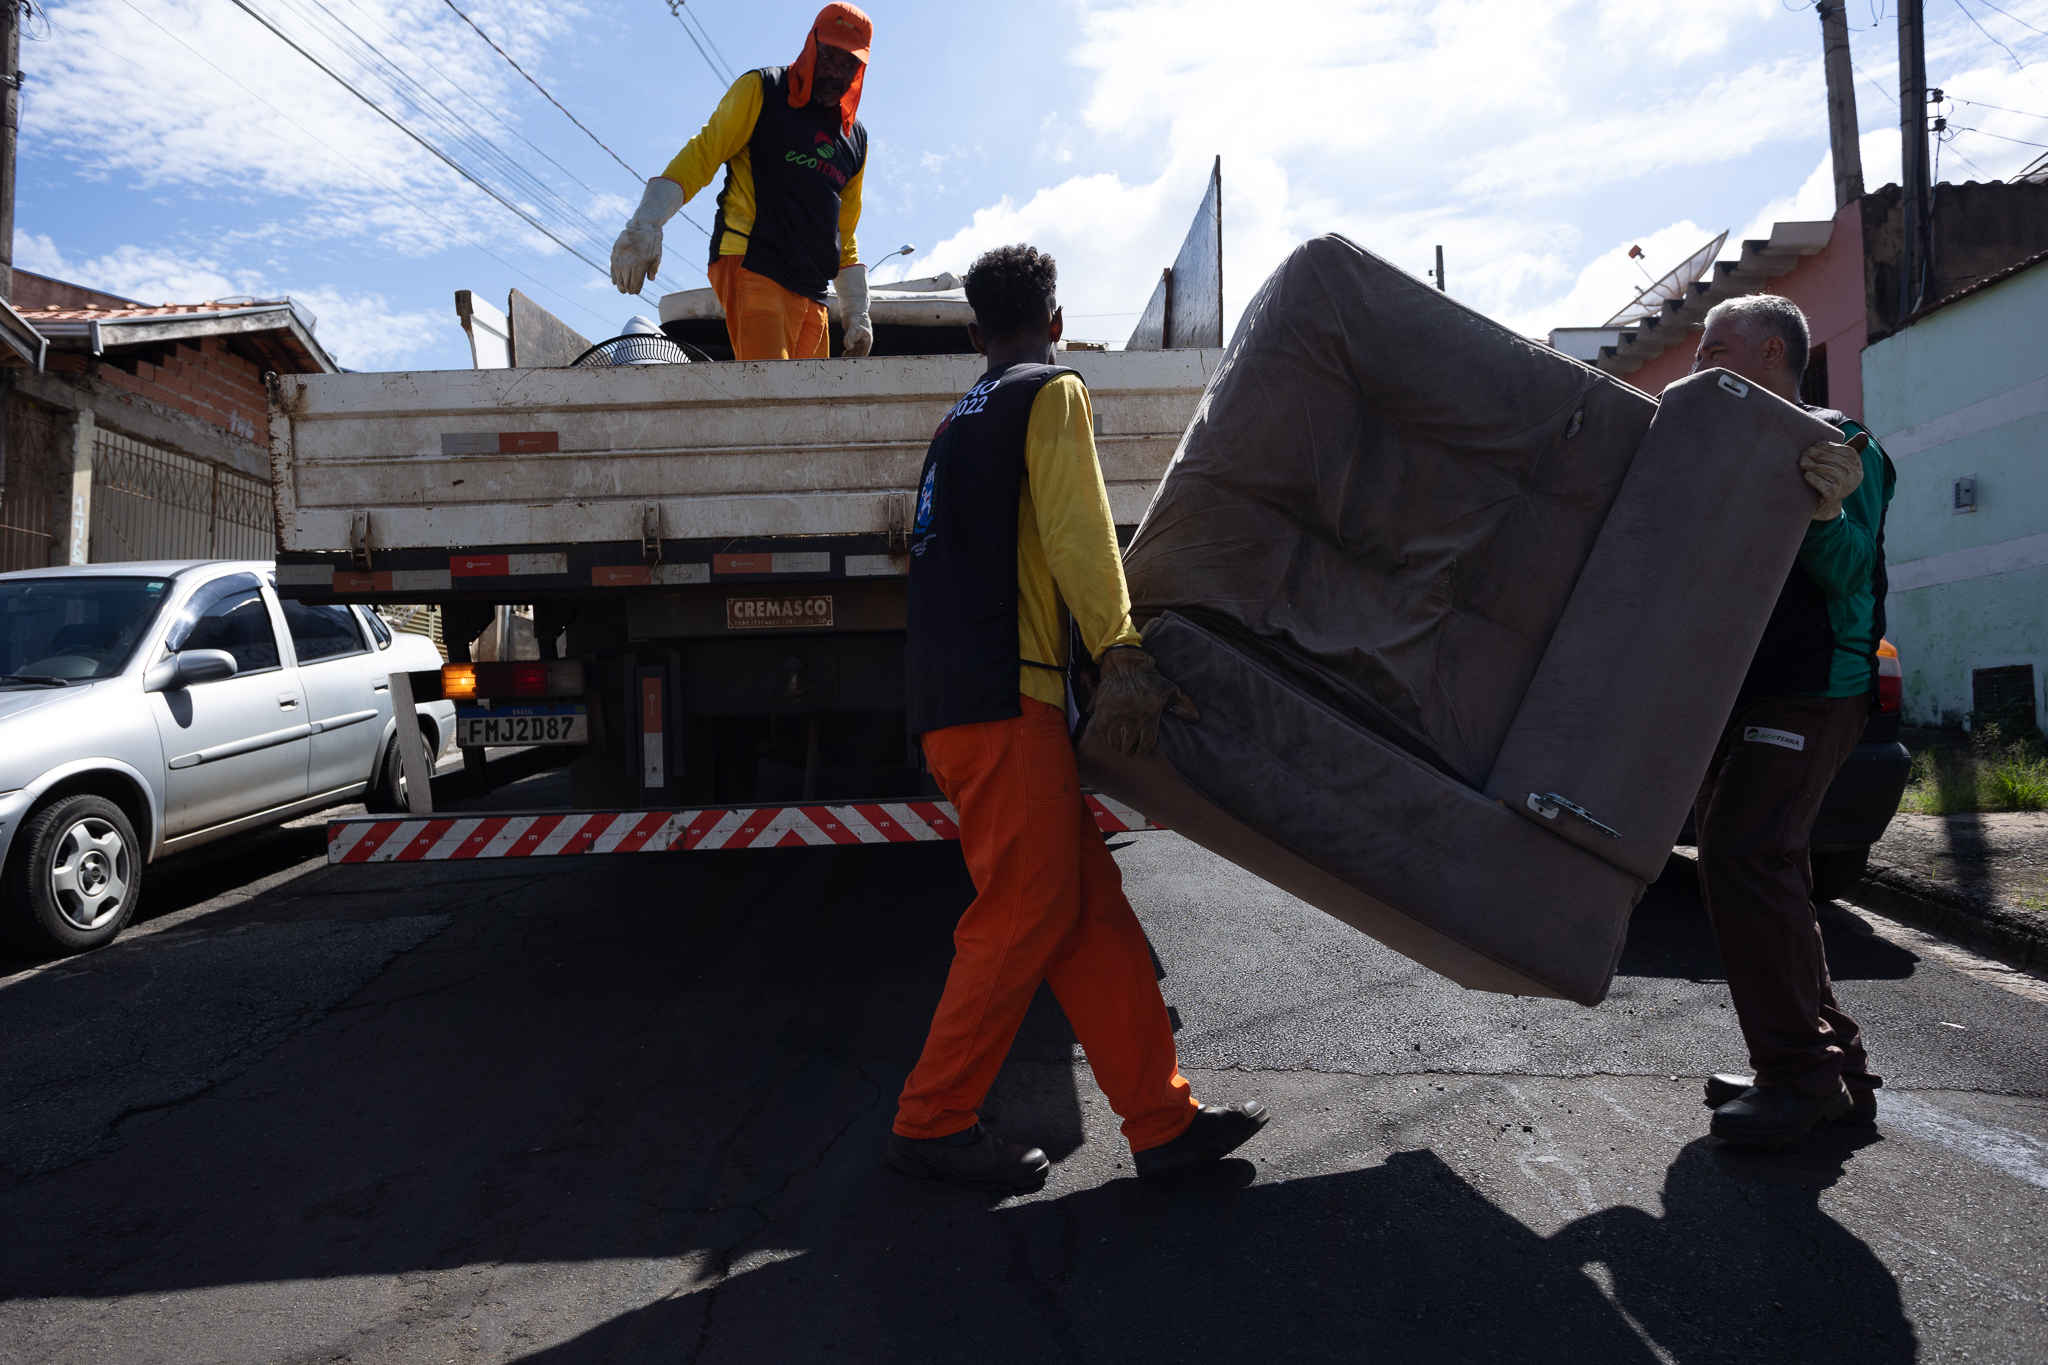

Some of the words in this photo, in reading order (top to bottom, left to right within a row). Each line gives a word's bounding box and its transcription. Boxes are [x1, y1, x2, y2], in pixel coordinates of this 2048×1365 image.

[73, 497, 85, 564] 146
[734, 599, 827, 618] CREMASCO
[469, 716, 574, 743] FMJ2D87
[1760, 733, 1800, 746] ecoTERRA
